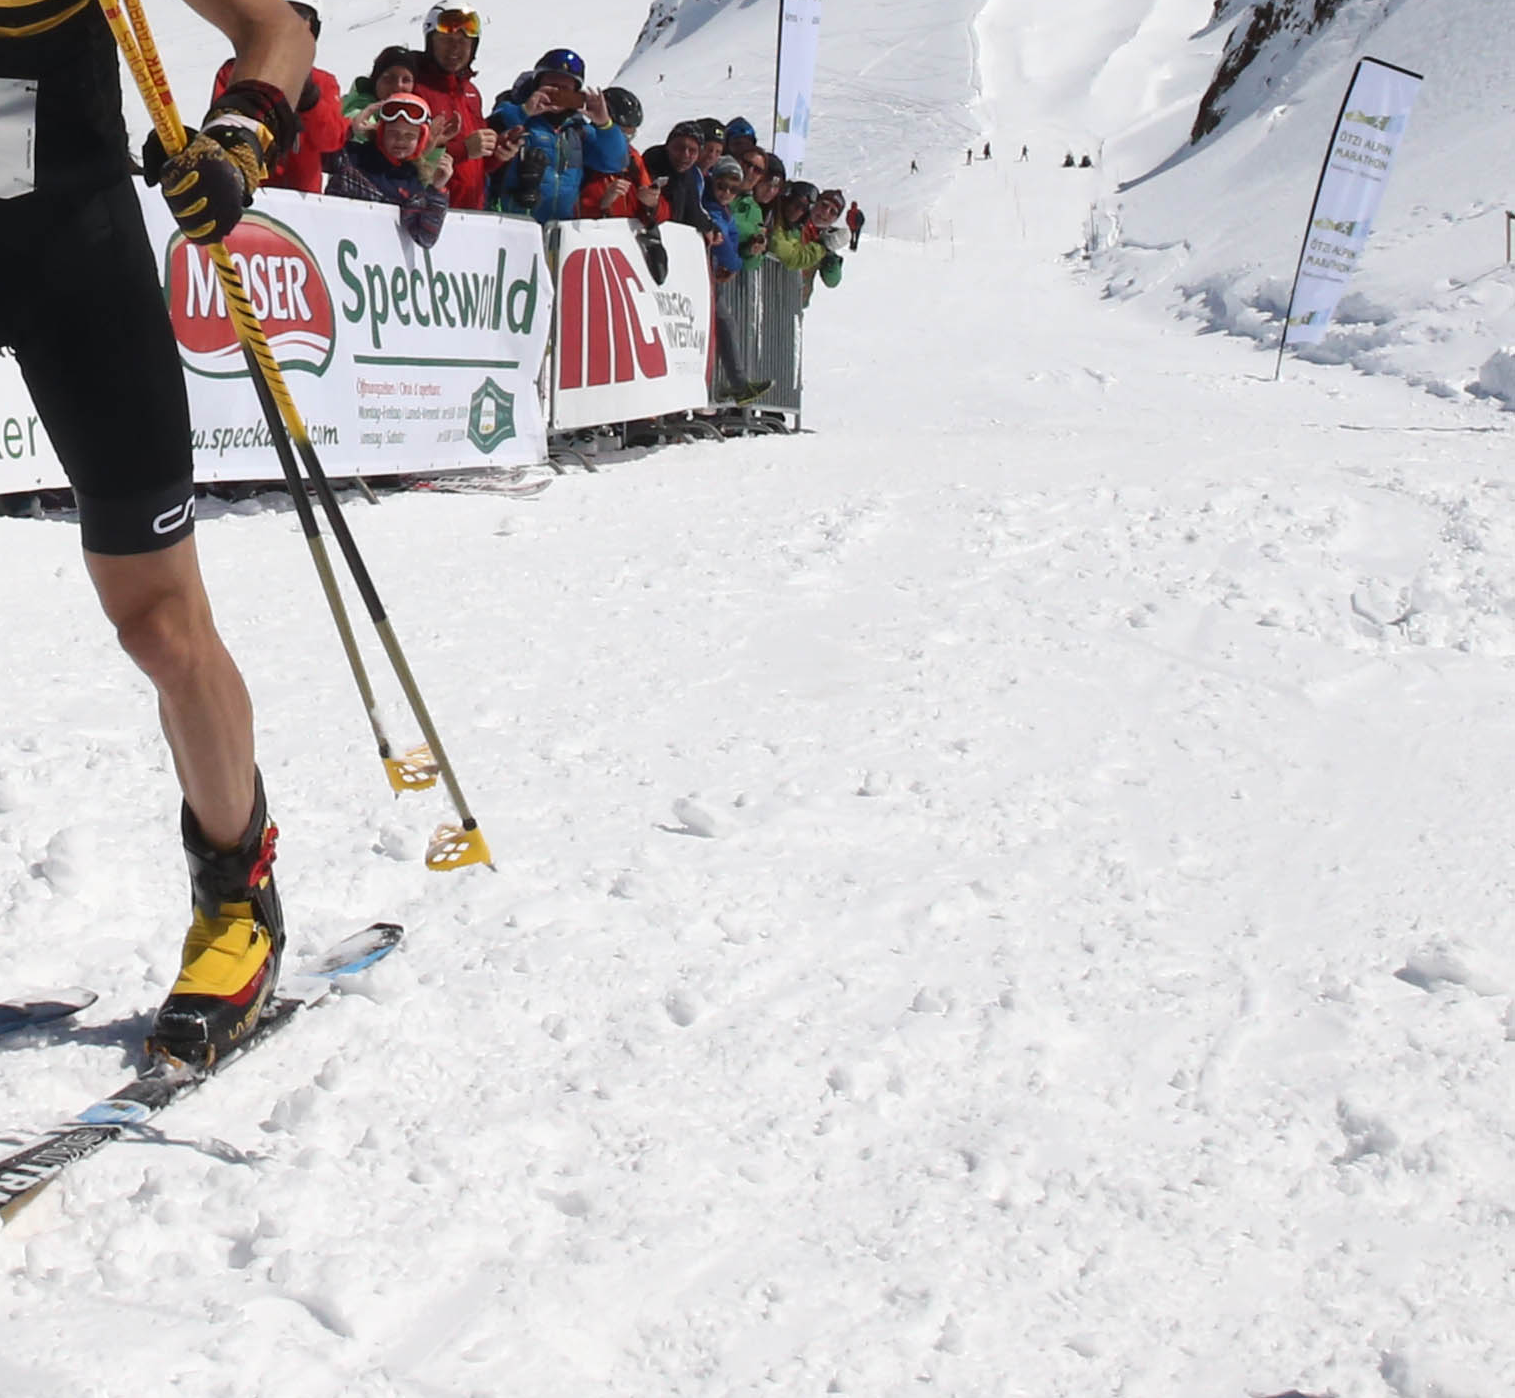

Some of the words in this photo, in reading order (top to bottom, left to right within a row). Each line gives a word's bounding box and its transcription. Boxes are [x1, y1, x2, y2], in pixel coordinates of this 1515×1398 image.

[118, 30, 151, 84] POLES
[1335, 146, 1389, 171] MARATHON
[1339, 129, 1363, 147] ÖTZI
[1364, 138, 1393, 156] ALPIN
[337, 238, 538, 350] Speckwald
